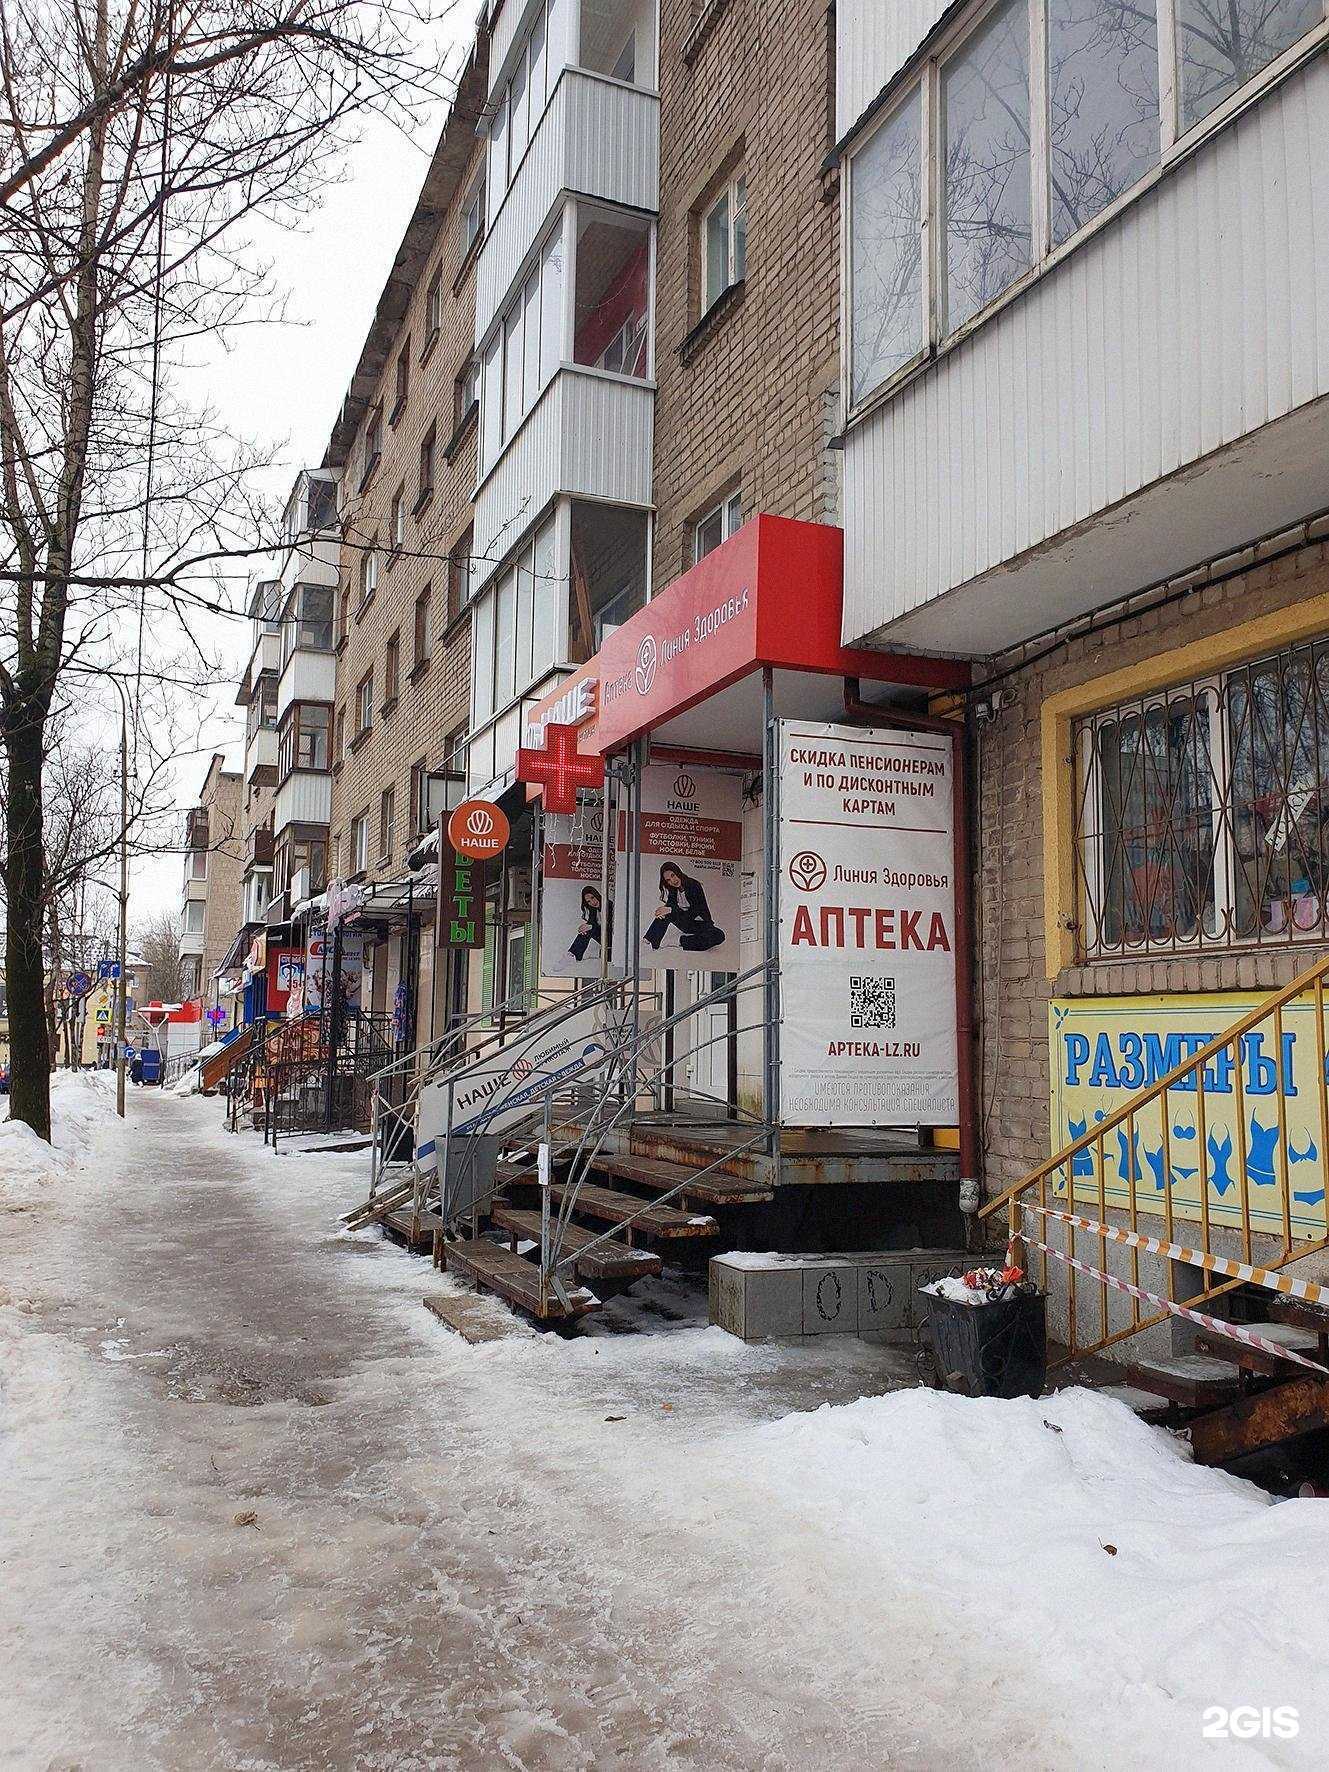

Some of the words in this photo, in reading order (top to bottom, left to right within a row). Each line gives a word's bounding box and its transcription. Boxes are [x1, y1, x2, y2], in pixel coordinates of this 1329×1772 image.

[659, 628, 691, 668] Линия
[694, 586, 749, 644] Здоровья
[790, 748, 847, 768] СКИДКА
[850, 753, 945, 777] ПЕНСИОНЕРАМ
[803, 772, 812, 787] И
[816, 773, 835, 789] ПО
[838, 775, 935, 797] ДИСКОНТНЫМ
[667, 800, 700, 812] НАШЕ
[842, 798, 896, 816] КАРТАМ
[661, 821, 689, 831] ОТДЫХА
[696, 825, 721, 834] СПОРТА
[669, 816, 699, 825] ОДЕЖДА
[460, 837, 500, 849] НАШЕ
[832, 864, 878, 885] Линия
[882, 867, 949, 891] Здоровья
[449, 849, 476, 944] ВЕТЫ
[790, 904, 952, 952] АПТЕКА
[534, 1037, 570, 1063] ЛЮБИМЫЙ
[828, 1041, 922, 1058] APTEKA-LZ.RU
[1063, 1031, 1299, 1097] РАЗМЕРЫ
[456, 1071, 512, 1111] НАШЕ
